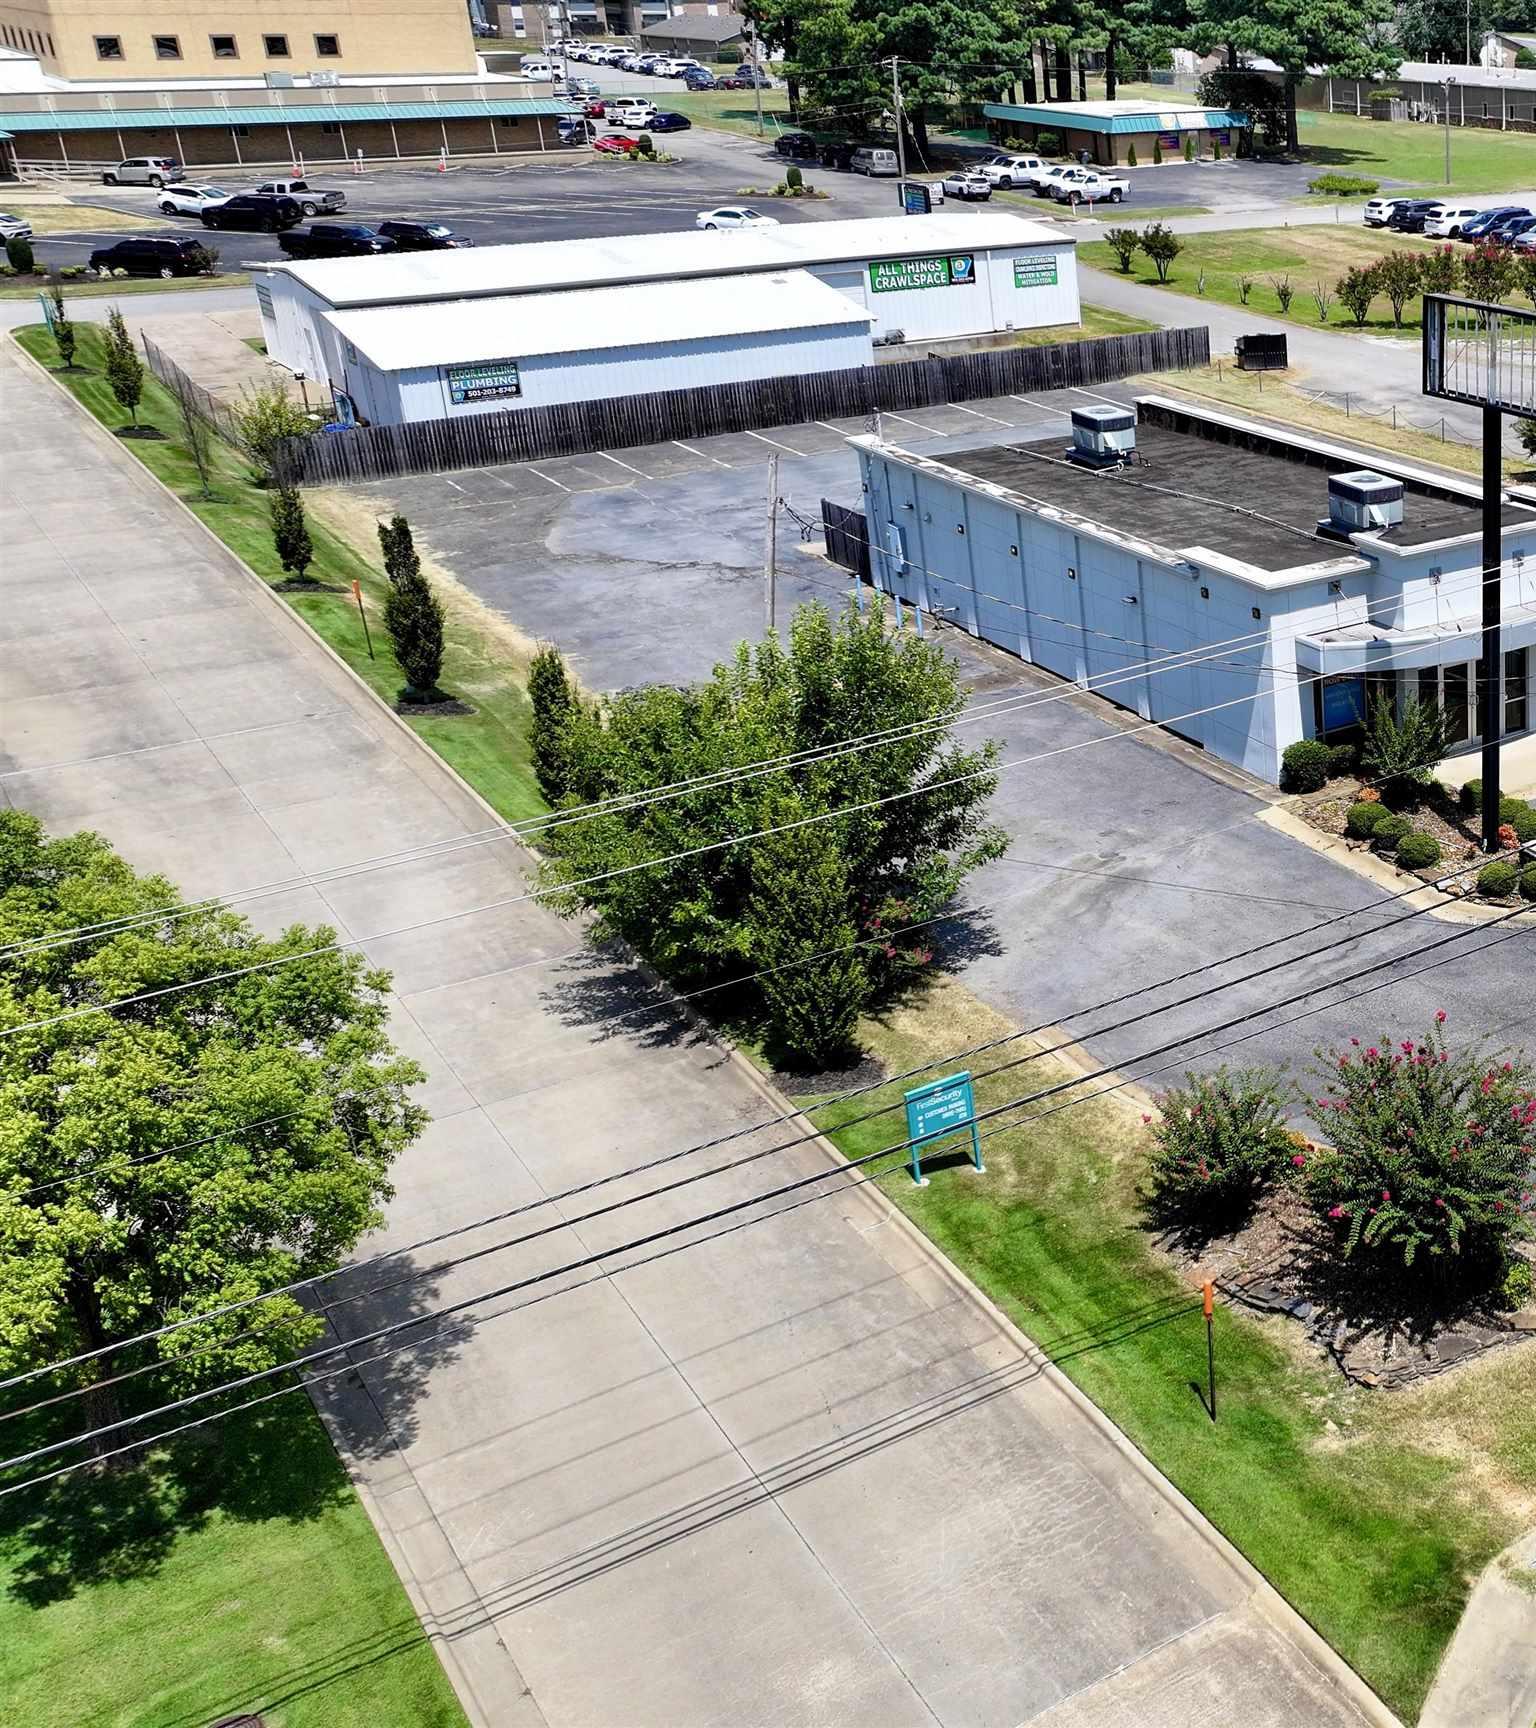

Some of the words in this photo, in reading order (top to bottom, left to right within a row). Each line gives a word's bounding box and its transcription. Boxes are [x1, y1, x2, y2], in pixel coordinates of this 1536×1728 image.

[878, 264, 898, 276] ALL
[900, 260, 942, 274] THINGS
[875, 272, 947, 289] CRAWLSPACE
[450, 369, 477, 380] FLOOR
[478, 365, 516, 377] LEVELING
[452, 376, 517, 390] PLUMBING
